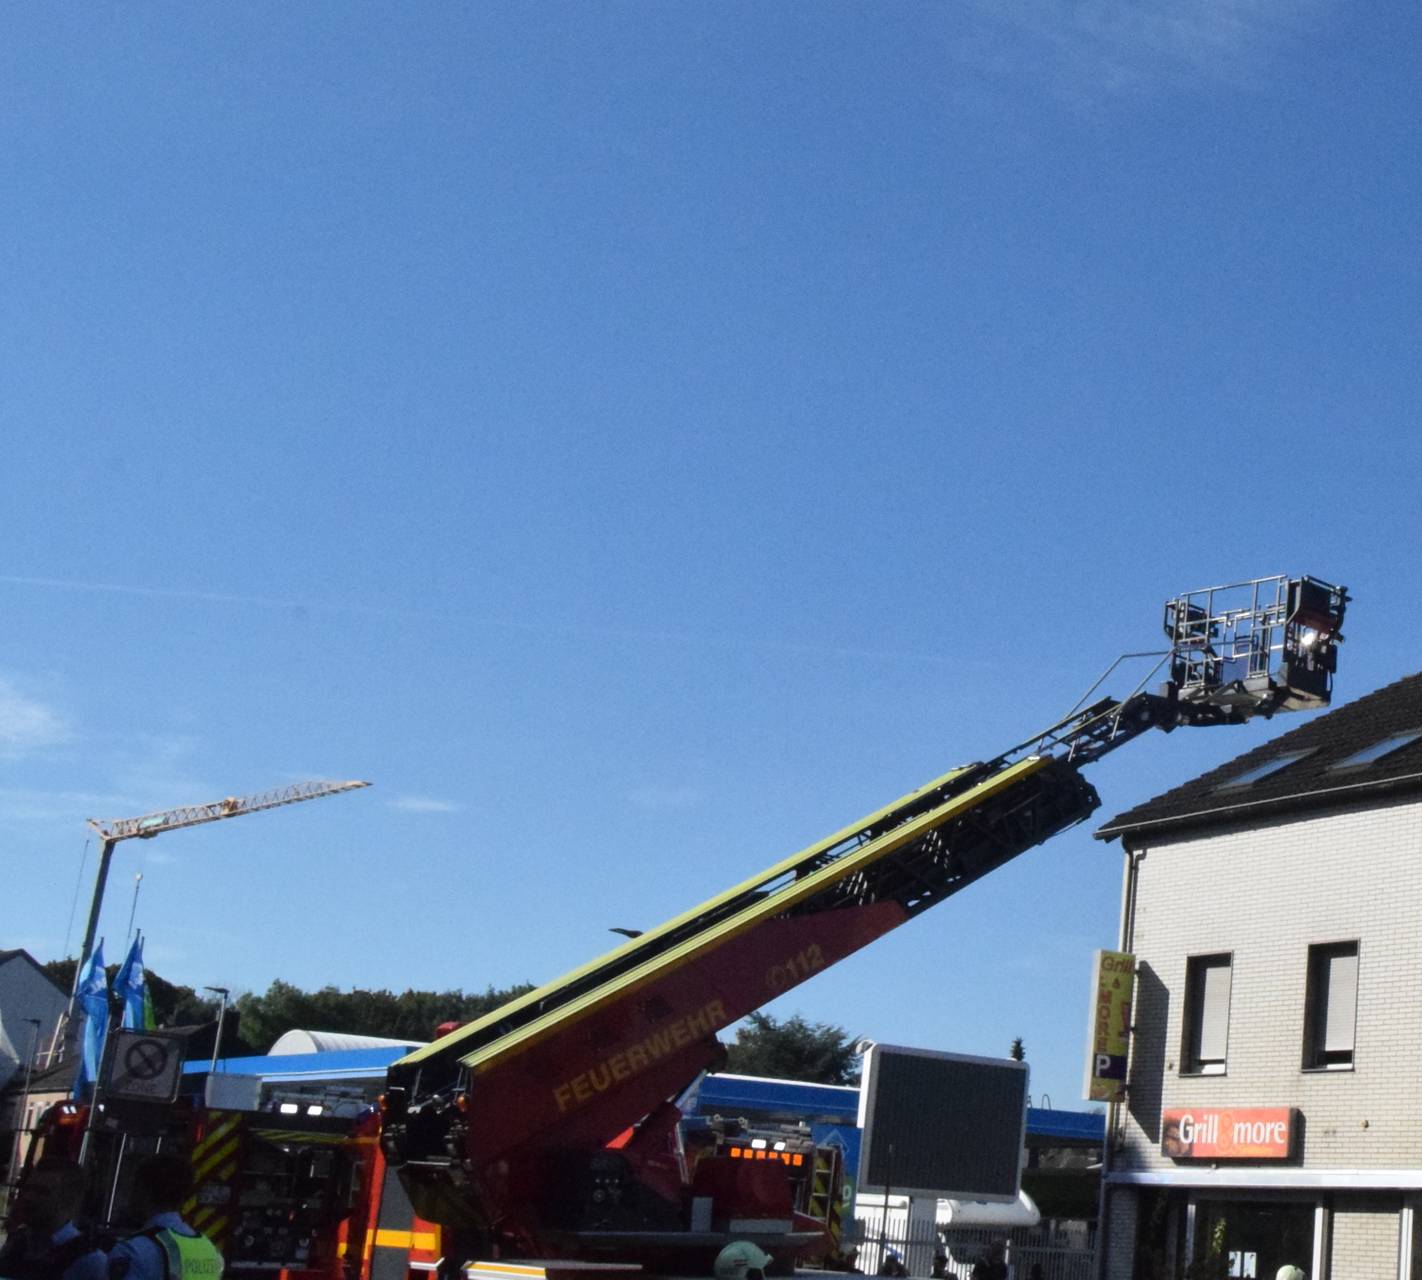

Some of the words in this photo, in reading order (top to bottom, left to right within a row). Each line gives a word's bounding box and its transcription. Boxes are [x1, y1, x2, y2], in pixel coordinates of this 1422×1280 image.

[1101, 956, 1135, 975] Grill
[554, 1001, 728, 1113] FEUERWEHR
[1095, 1054, 1111, 1077] P
[1180, 1114, 1219, 1143] Grill
[1233, 1120, 1286, 1143] more
